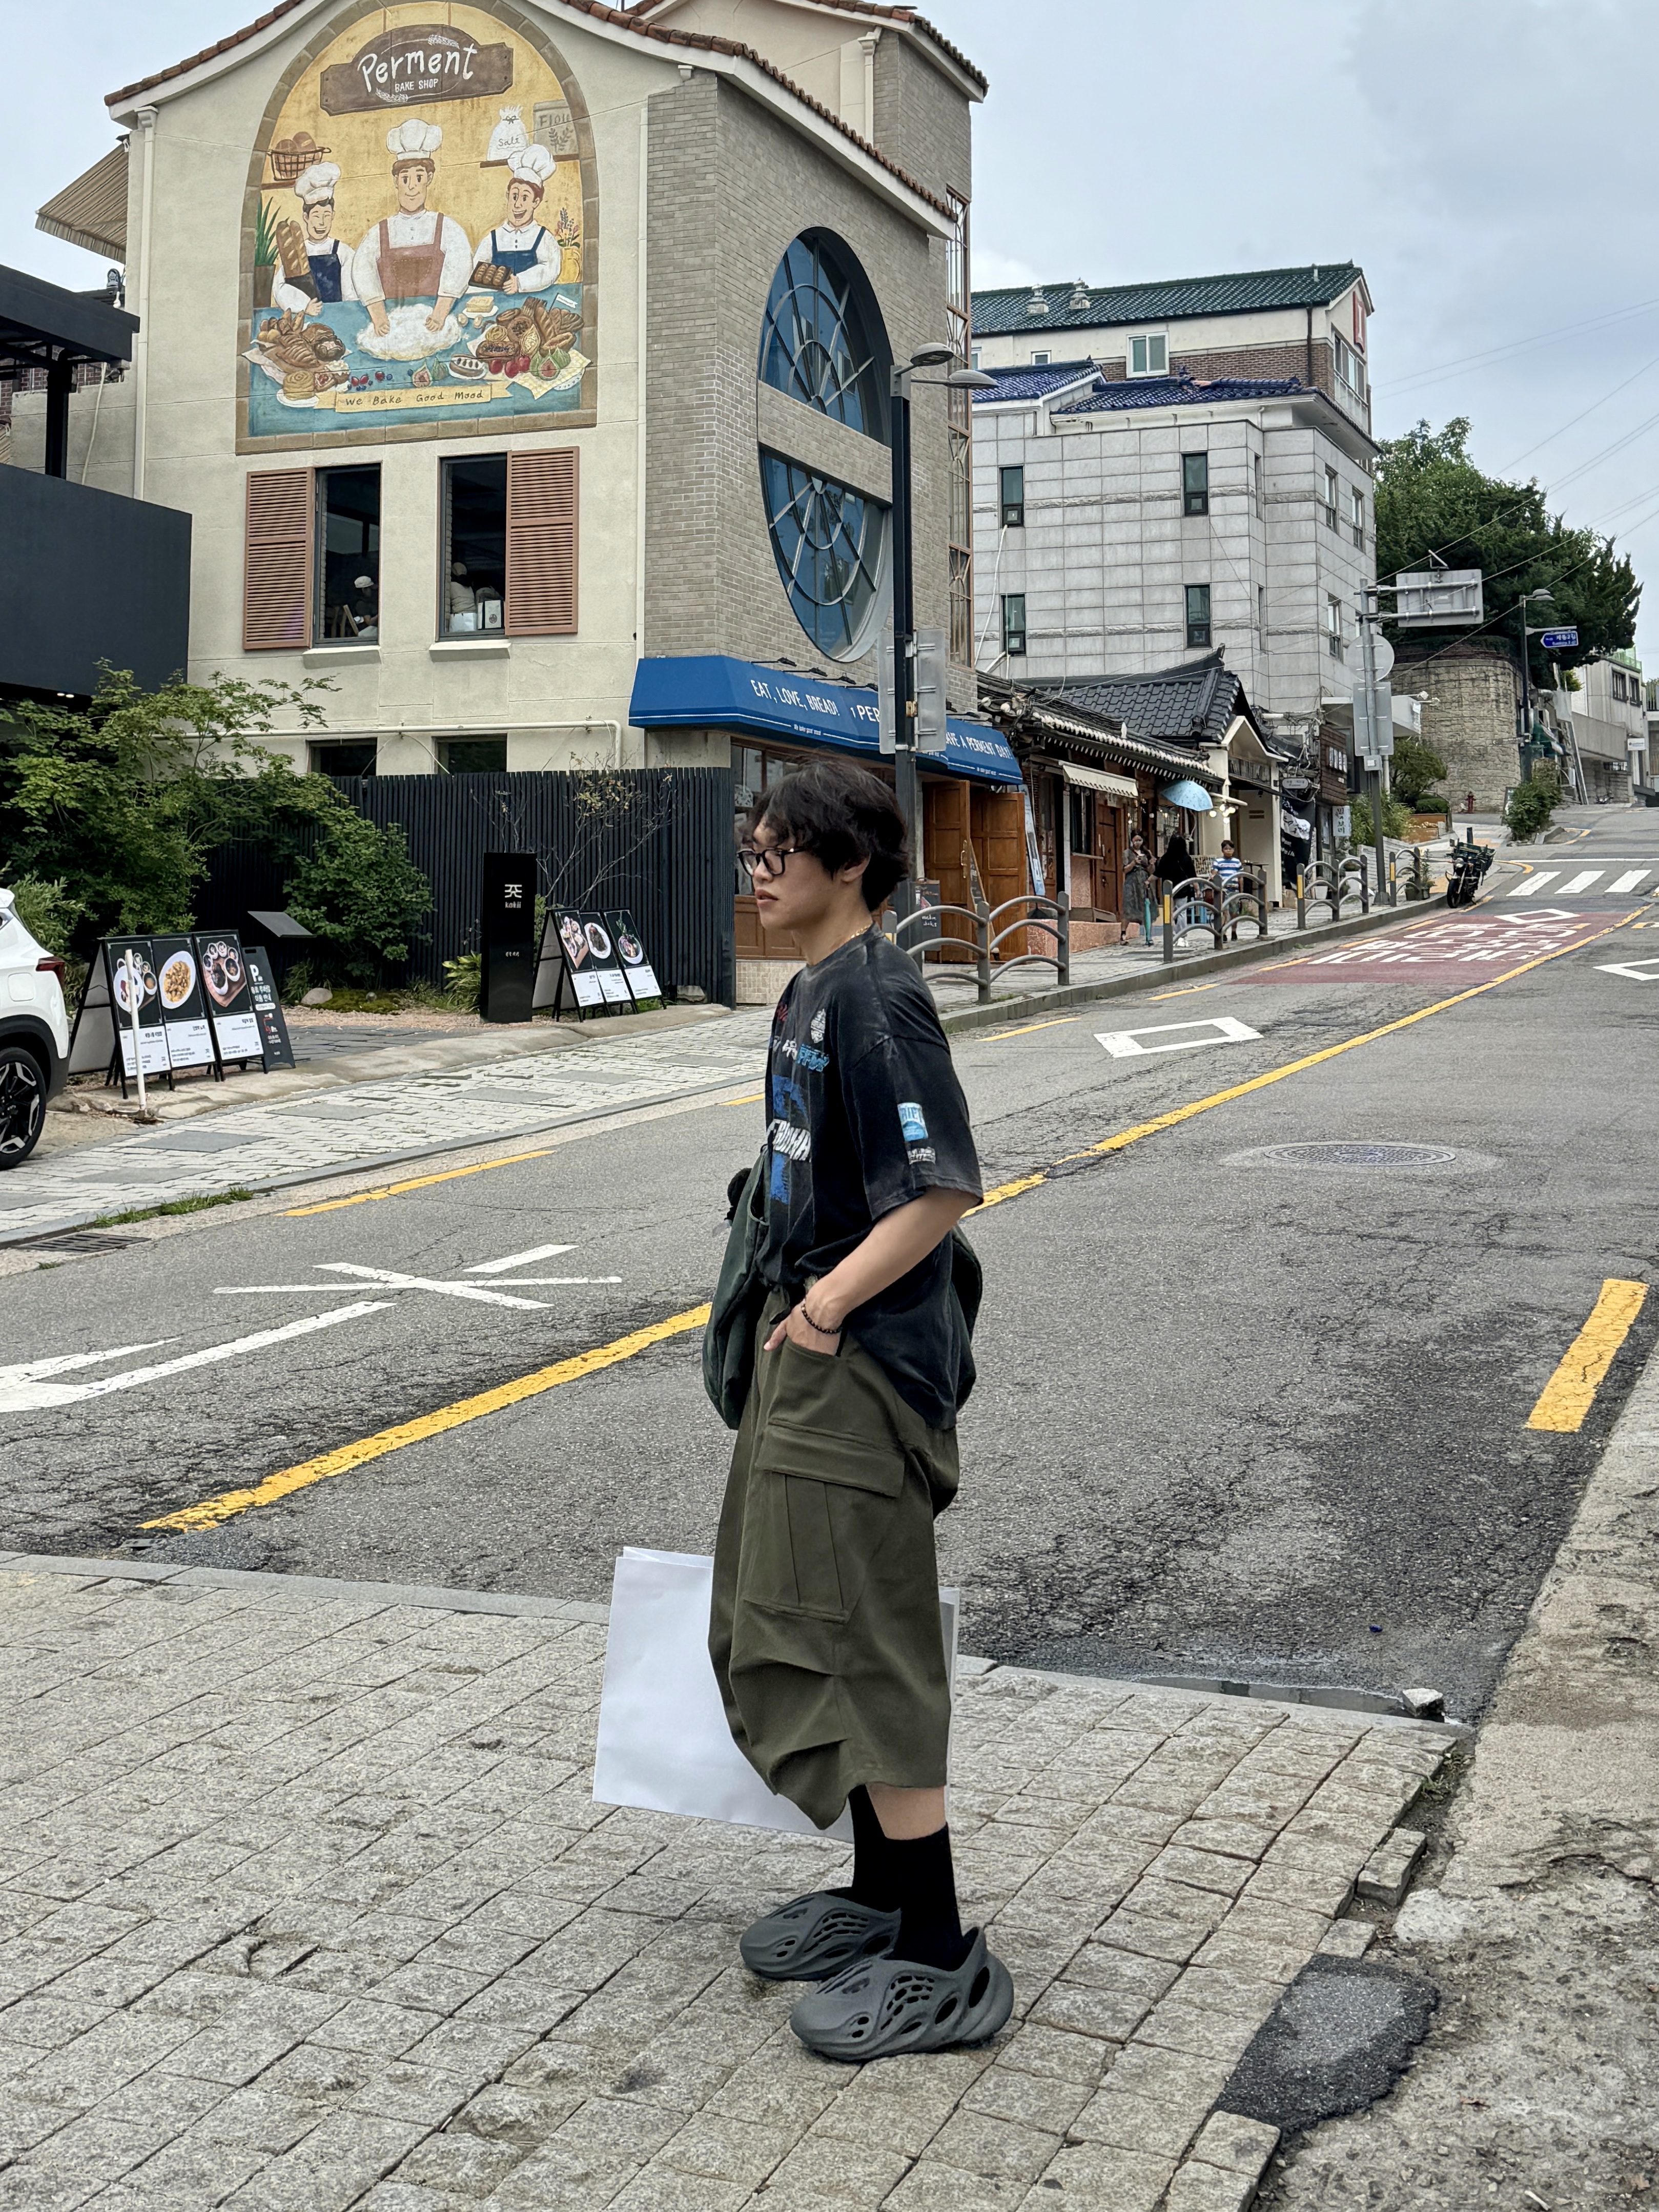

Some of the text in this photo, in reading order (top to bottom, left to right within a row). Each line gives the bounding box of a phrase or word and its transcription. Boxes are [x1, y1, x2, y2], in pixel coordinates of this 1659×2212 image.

[357, 43, 478, 92] Perment
[395, 78, 439, 93] BAKE SHOP
[373, 396, 402, 405] Bake
[416, 392, 444, 402] Good
[455, 390, 483, 400] Mood
[775, 687, 809, 711] LOVE,
[806, 694, 841, 716] BREAD!
[946, 732, 960, 747] AVE
[959, 735, 968, 749] A
[994, 744, 1013, 760] DAY!
[249, 965, 259, 982] P
